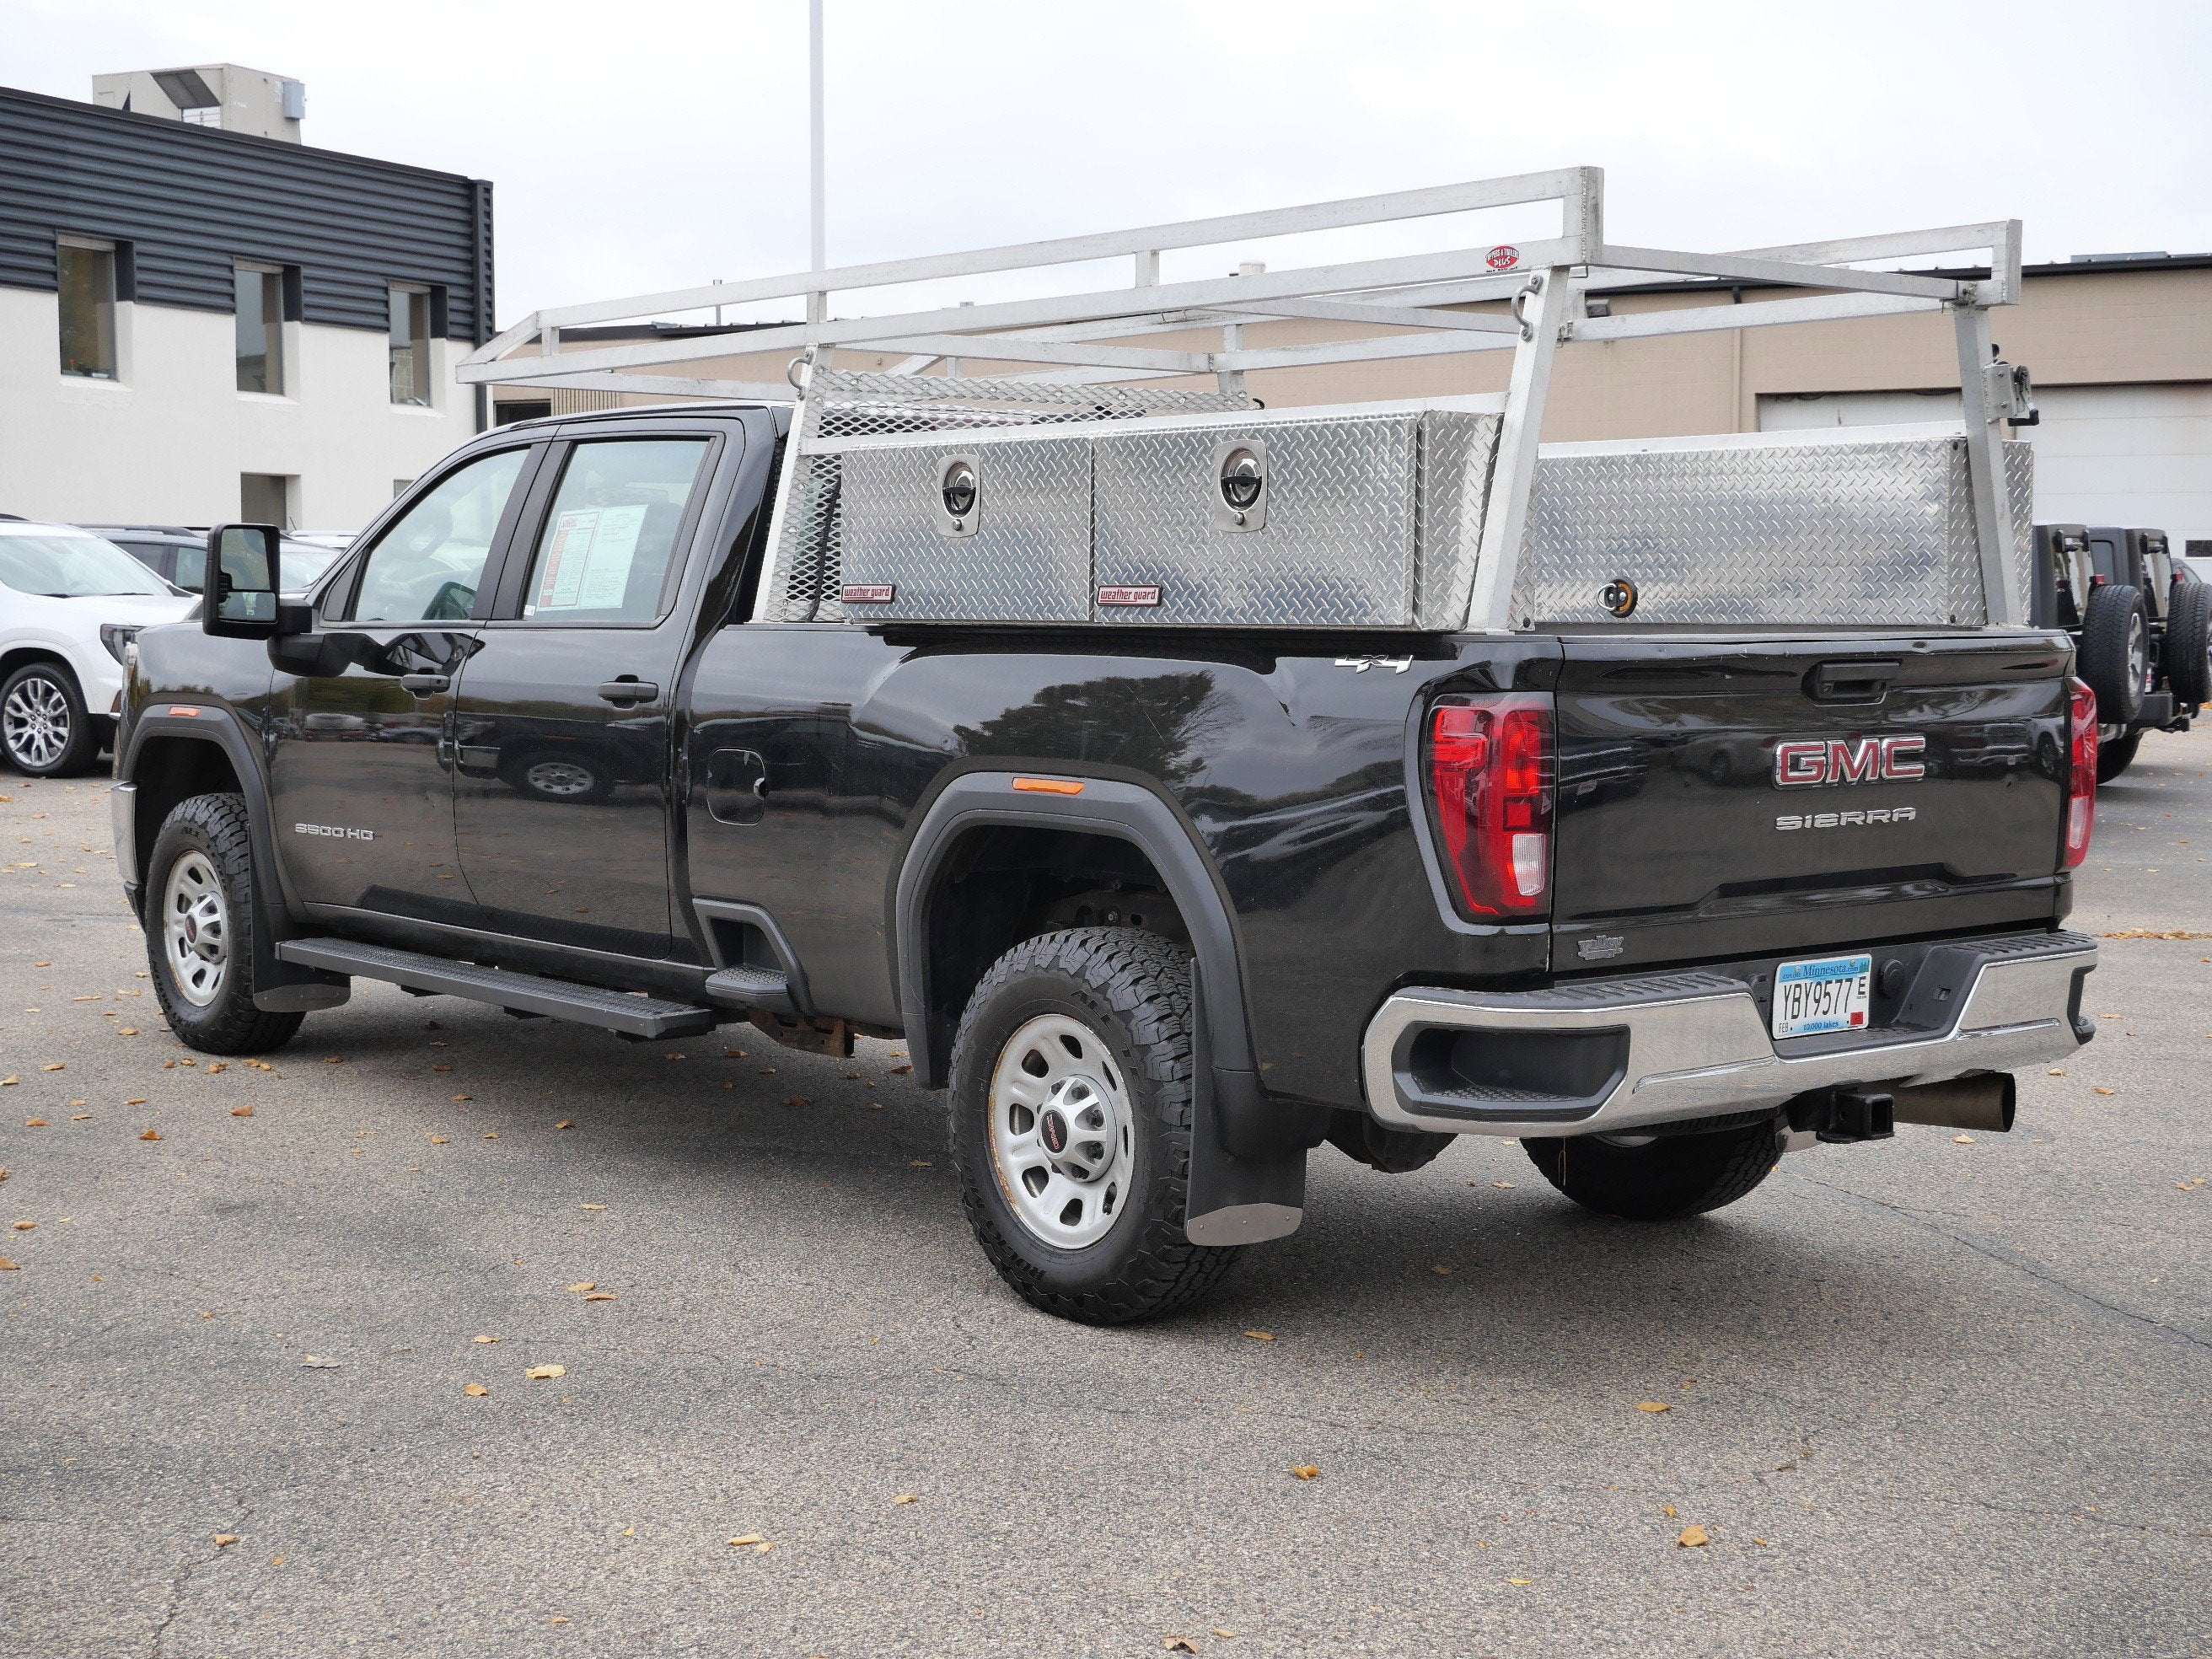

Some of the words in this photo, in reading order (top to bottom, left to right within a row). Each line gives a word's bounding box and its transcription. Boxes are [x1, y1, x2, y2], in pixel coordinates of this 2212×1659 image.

[1494, 256, 1510, 268] PLUS
[844, 587, 870, 597] weather
[871, 587, 890, 598] guard
[1100, 588, 1132, 599] weather
[1133, 588, 1156, 601] guard
[1775, 734, 1926, 787] GMC
[1774, 807, 1916, 830] SIERRA
[295, 823, 345, 838] 3500
[347, 828, 374, 840] HD
[1858, 976, 1867, 996] E
[1784, 978, 1853, 1020] YBY9577
[1779, 1022, 1789, 1034] FEB
[1803, 1023, 1823, 1032] 10,000
[1823, 1021, 1839, 1030] lakes
